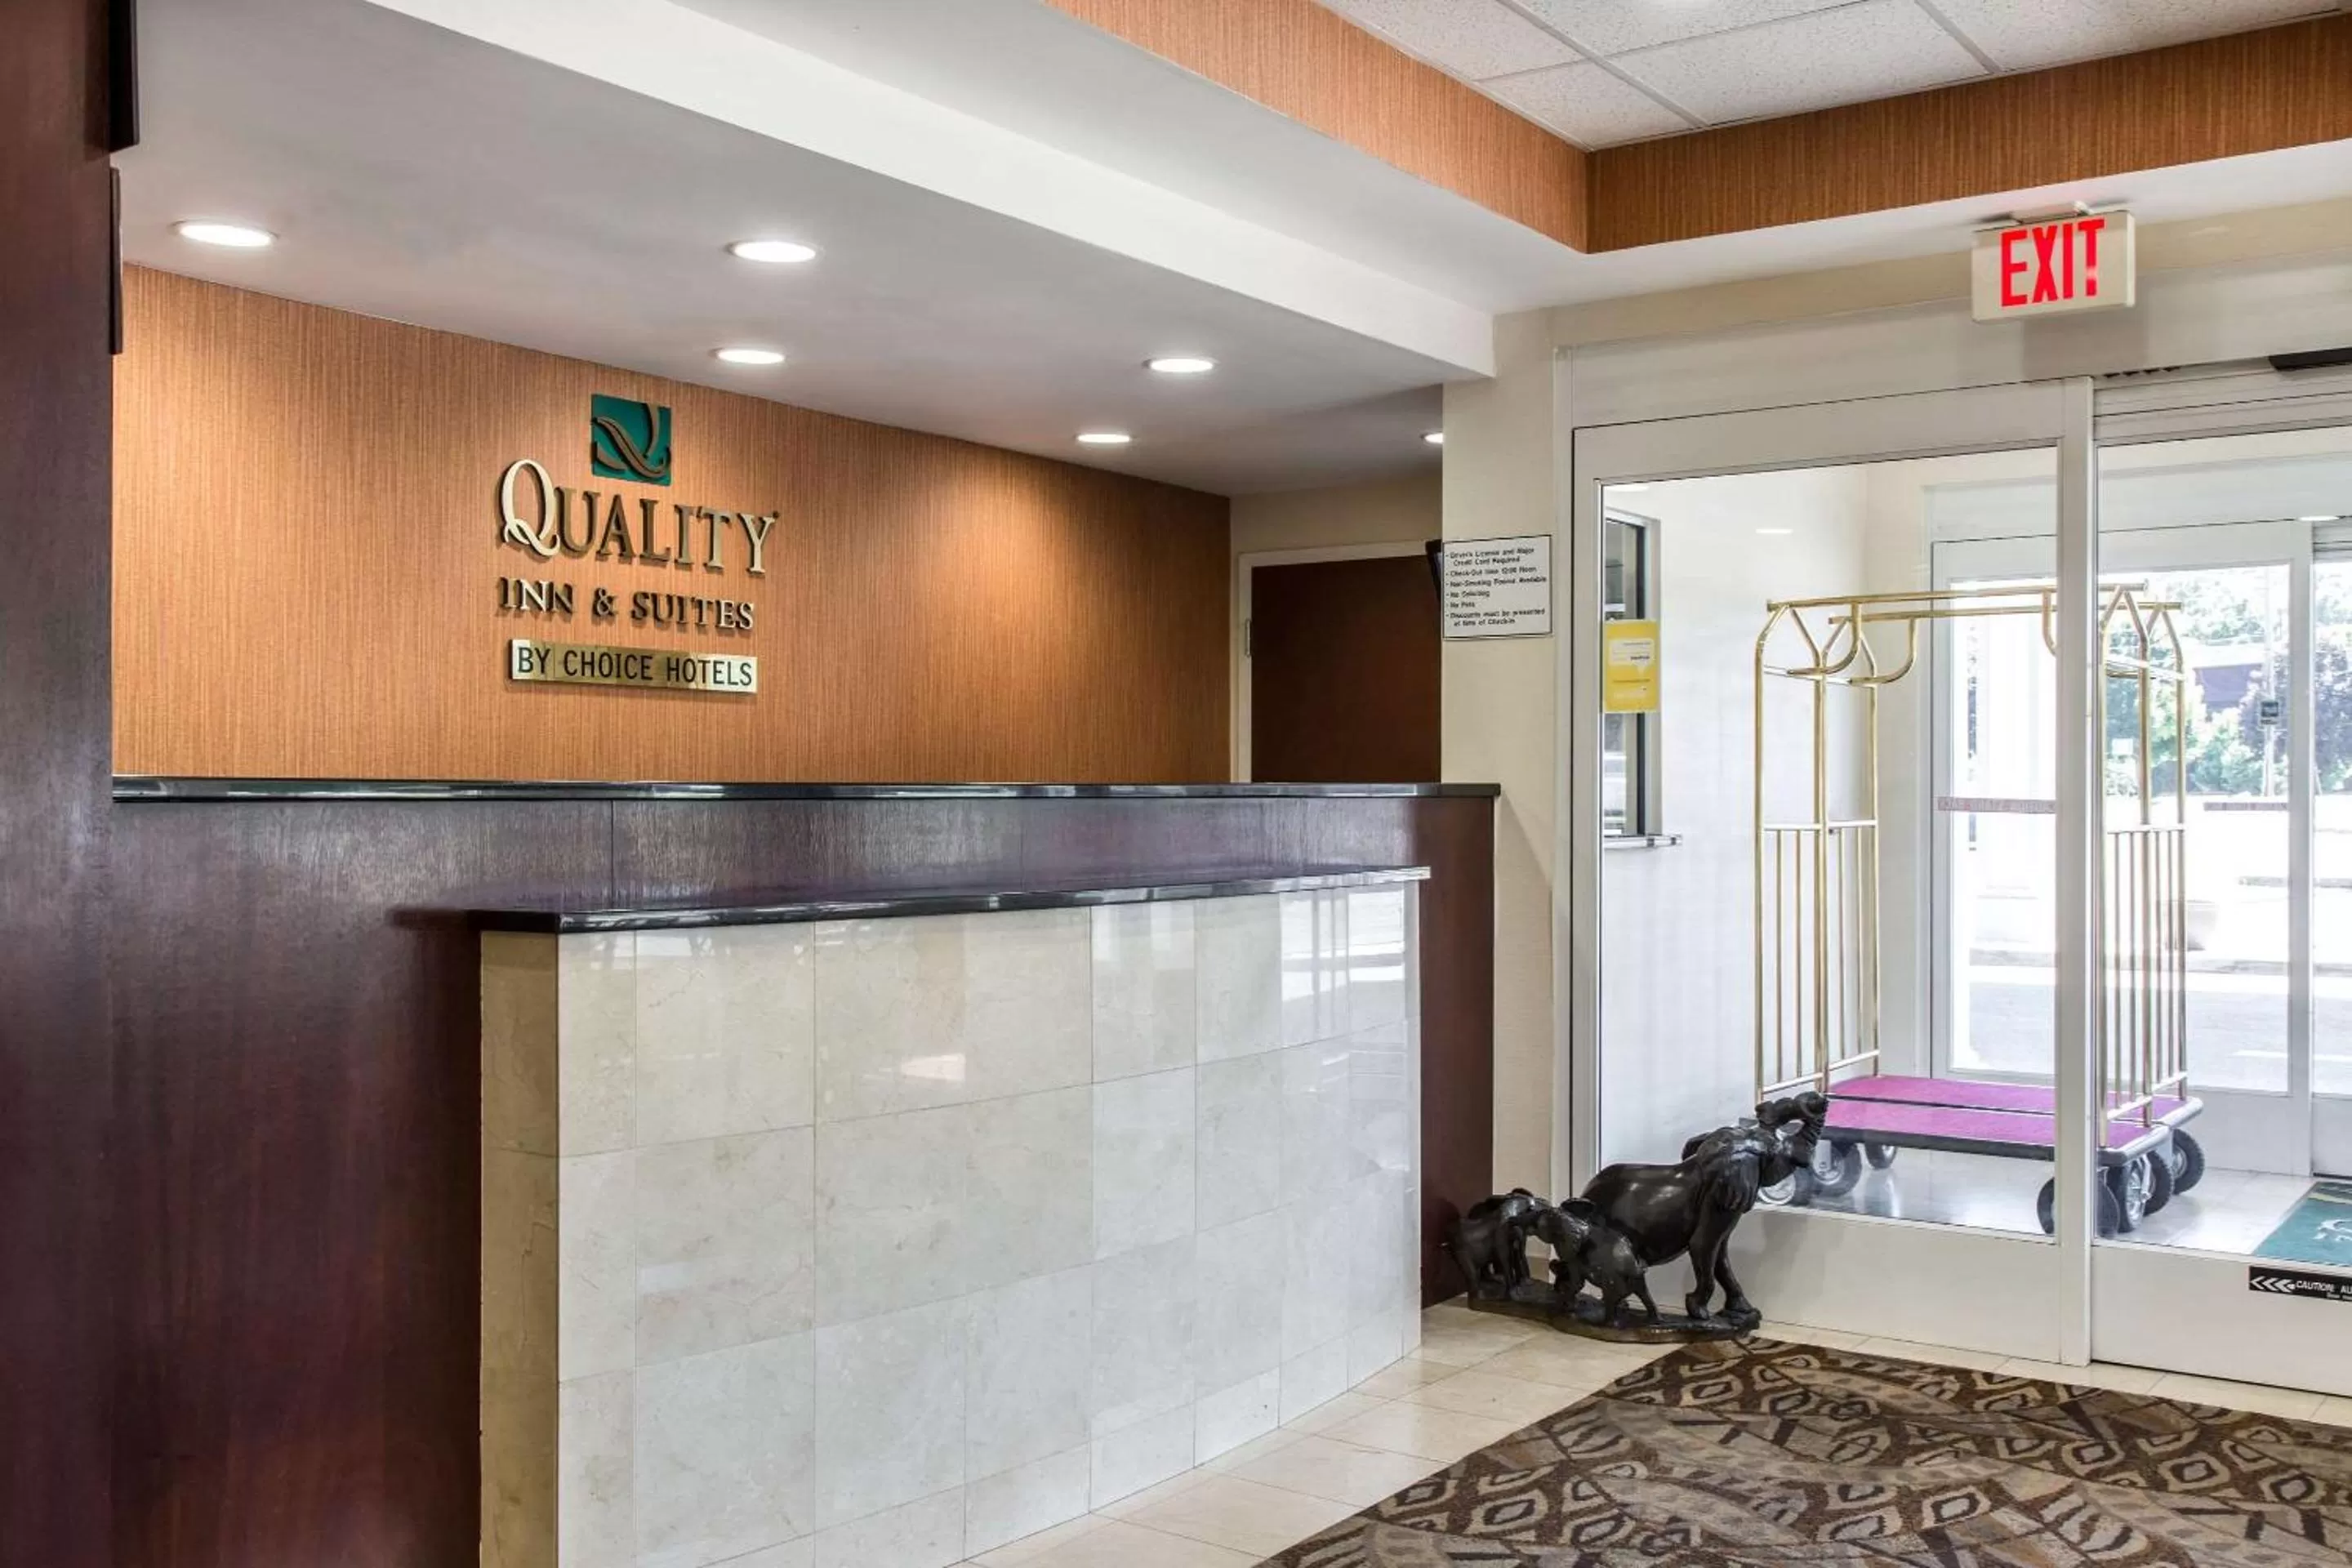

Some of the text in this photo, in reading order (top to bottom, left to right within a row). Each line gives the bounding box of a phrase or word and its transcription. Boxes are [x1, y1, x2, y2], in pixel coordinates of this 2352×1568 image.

[2000, 217, 2105, 308] EXIT
[501, 458, 776, 574] QUALITY
[499, 577, 755, 630] INN & SUITES
[517, 646, 754, 688] BY CHOICE HOTELS
